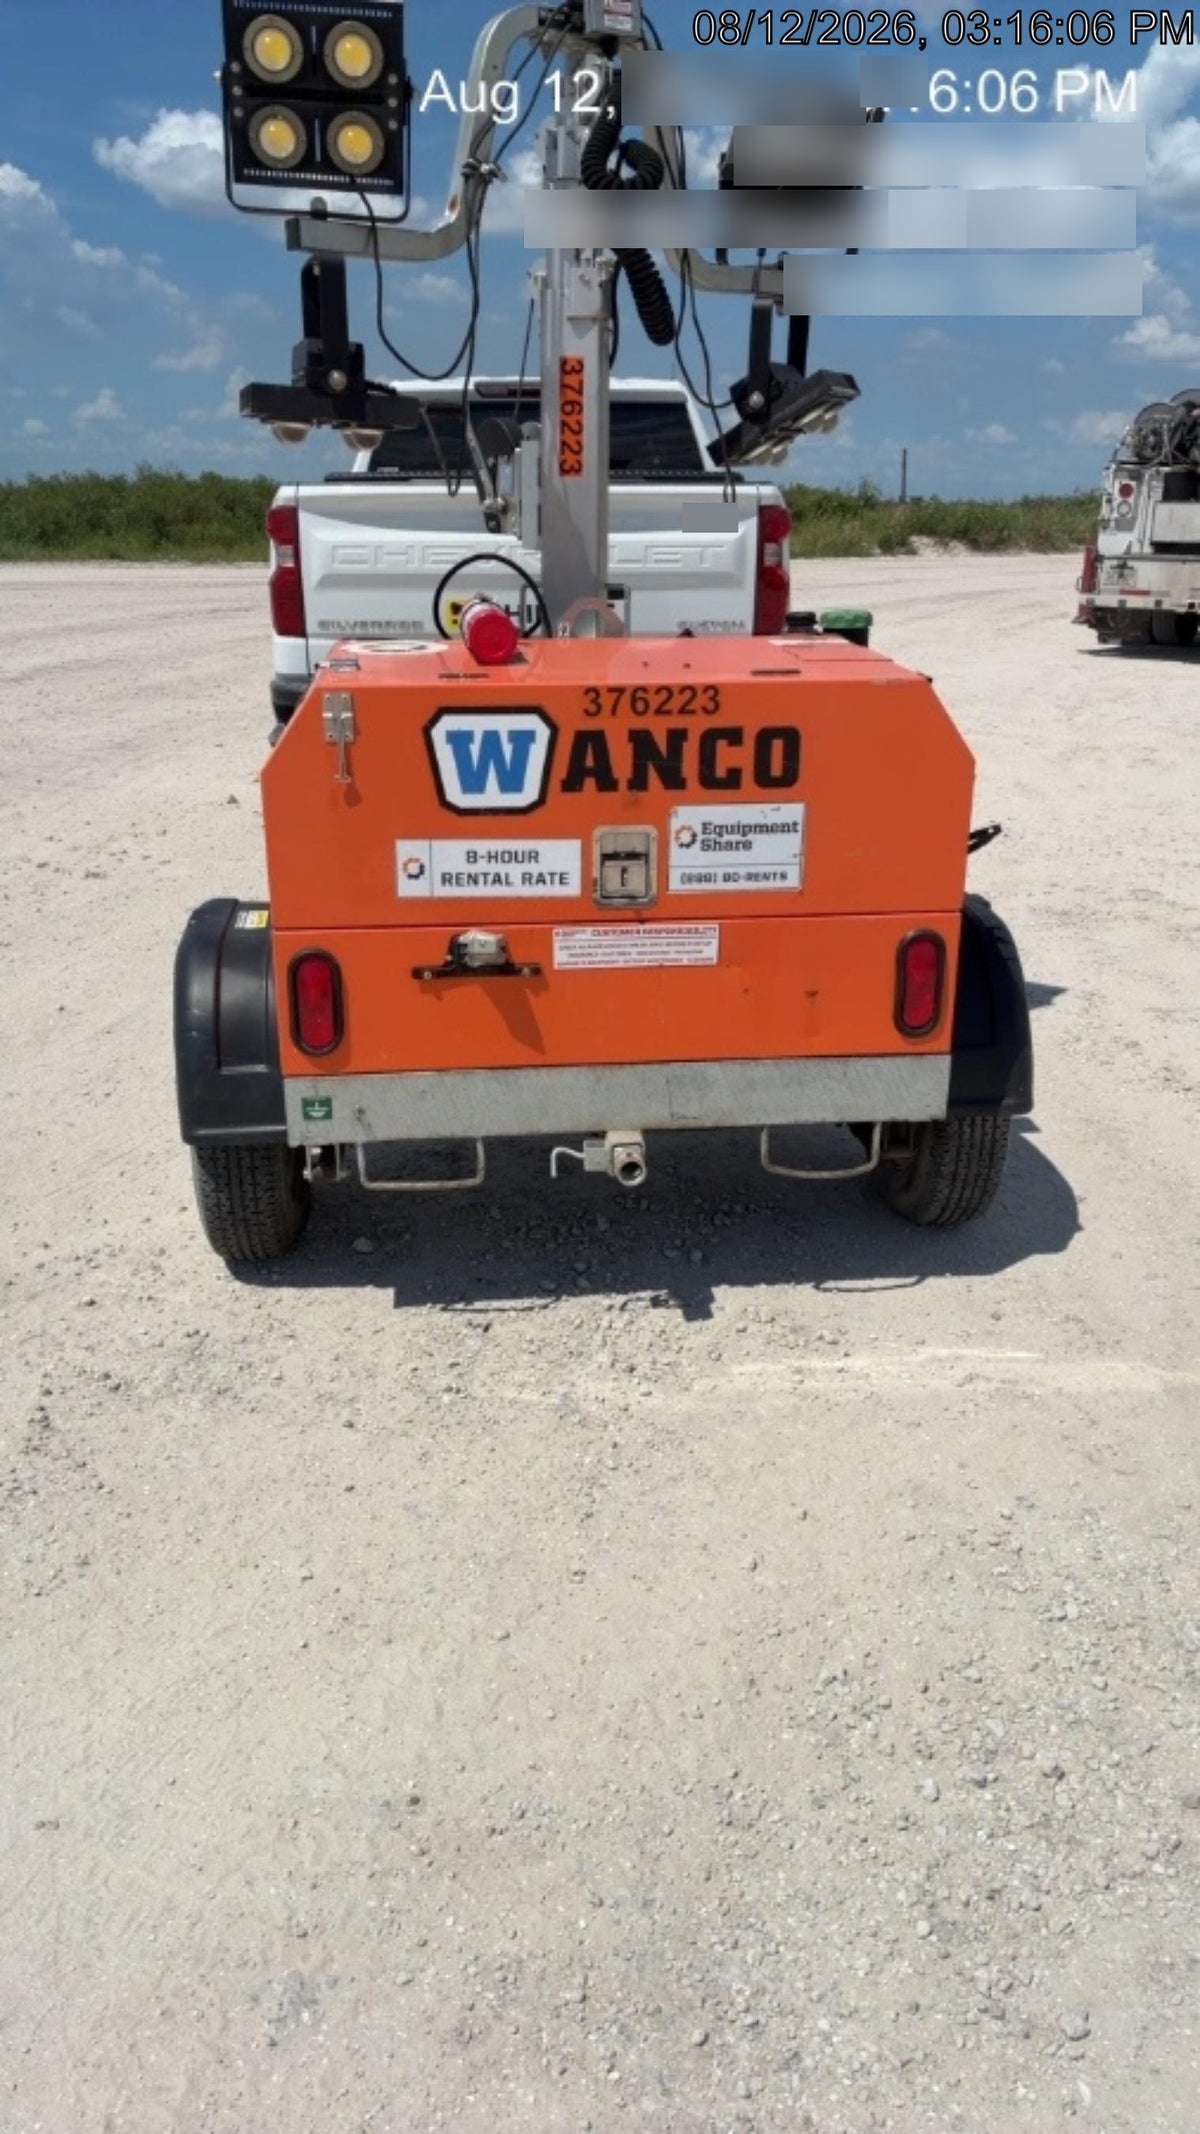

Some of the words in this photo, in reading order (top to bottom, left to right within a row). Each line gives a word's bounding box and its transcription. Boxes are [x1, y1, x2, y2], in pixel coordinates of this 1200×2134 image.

[560, 357, 584, 476] 376223
[582, 685, 721, 717] 376223
[445, 726, 802, 795] WANCO
[701, 820, 800, 838] Equipment
[701, 837, 753, 852] Share
[466, 850, 540, 865] 8-HOUR
[441, 871, 514, 888] RENTAL
[521, 871, 570, 887] RATE
